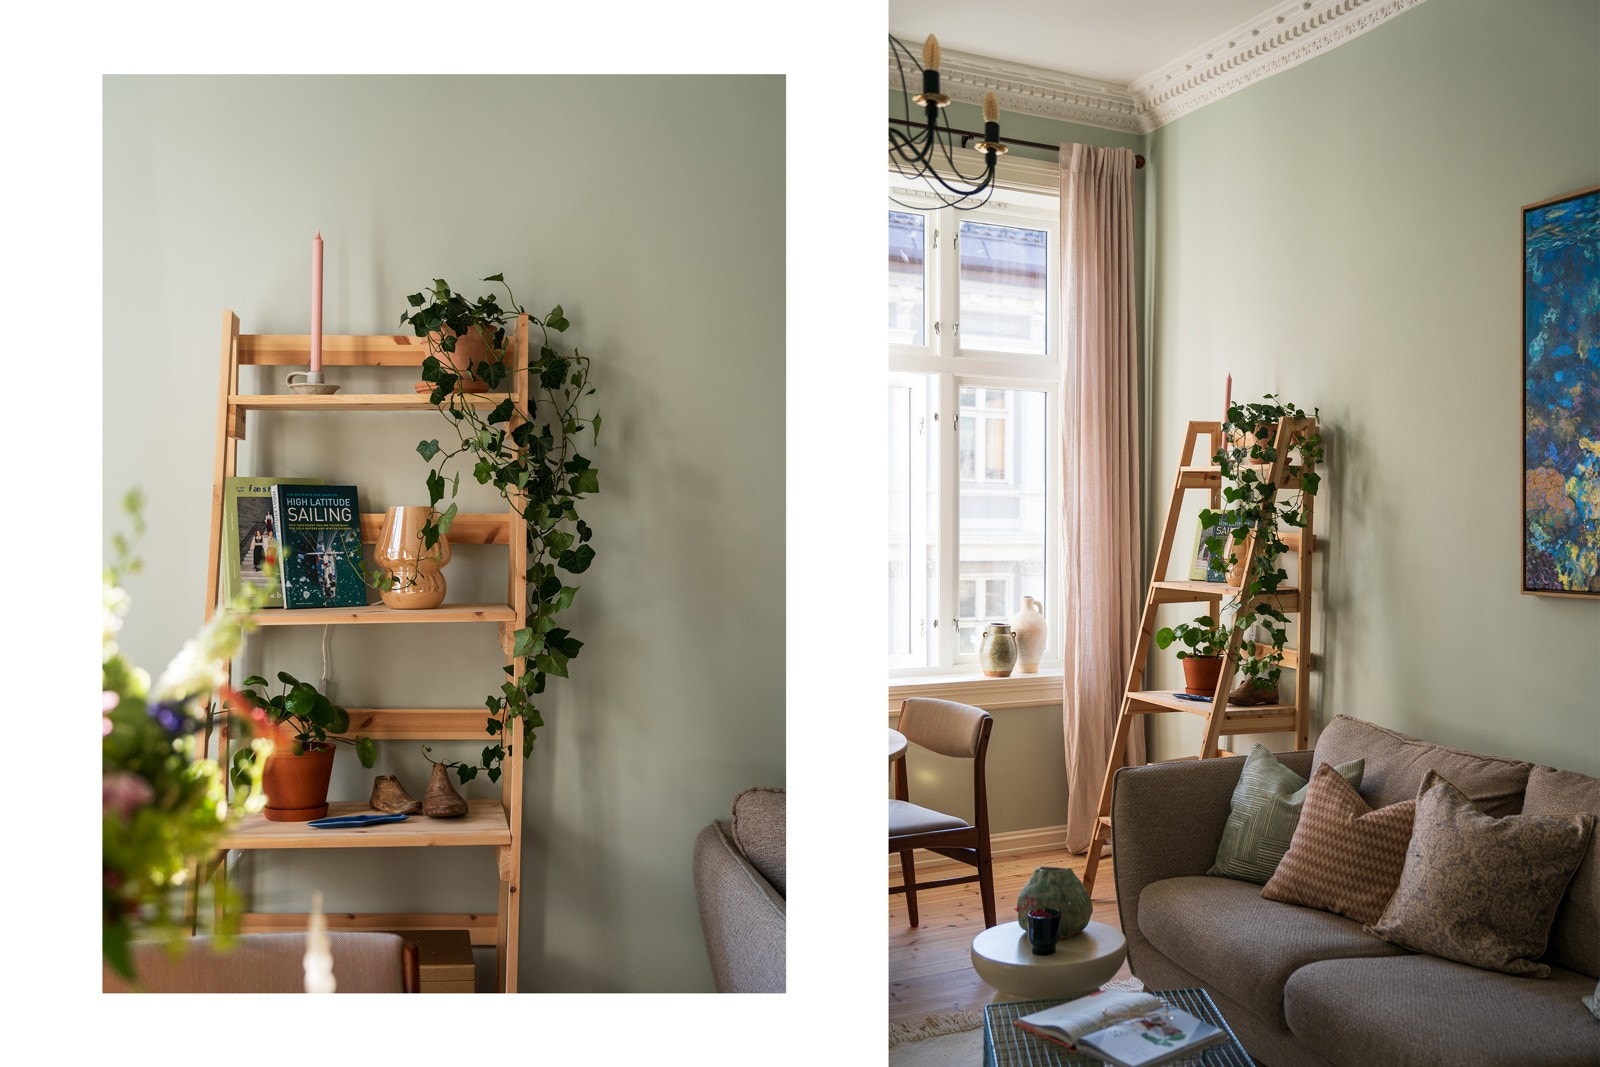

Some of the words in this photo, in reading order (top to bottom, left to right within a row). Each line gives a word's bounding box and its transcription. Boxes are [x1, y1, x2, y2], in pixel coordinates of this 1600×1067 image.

[286, 498, 308, 506] HIGH
[310, 498, 351, 507] LATITUDE
[287, 507, 352, 522] SAILING
